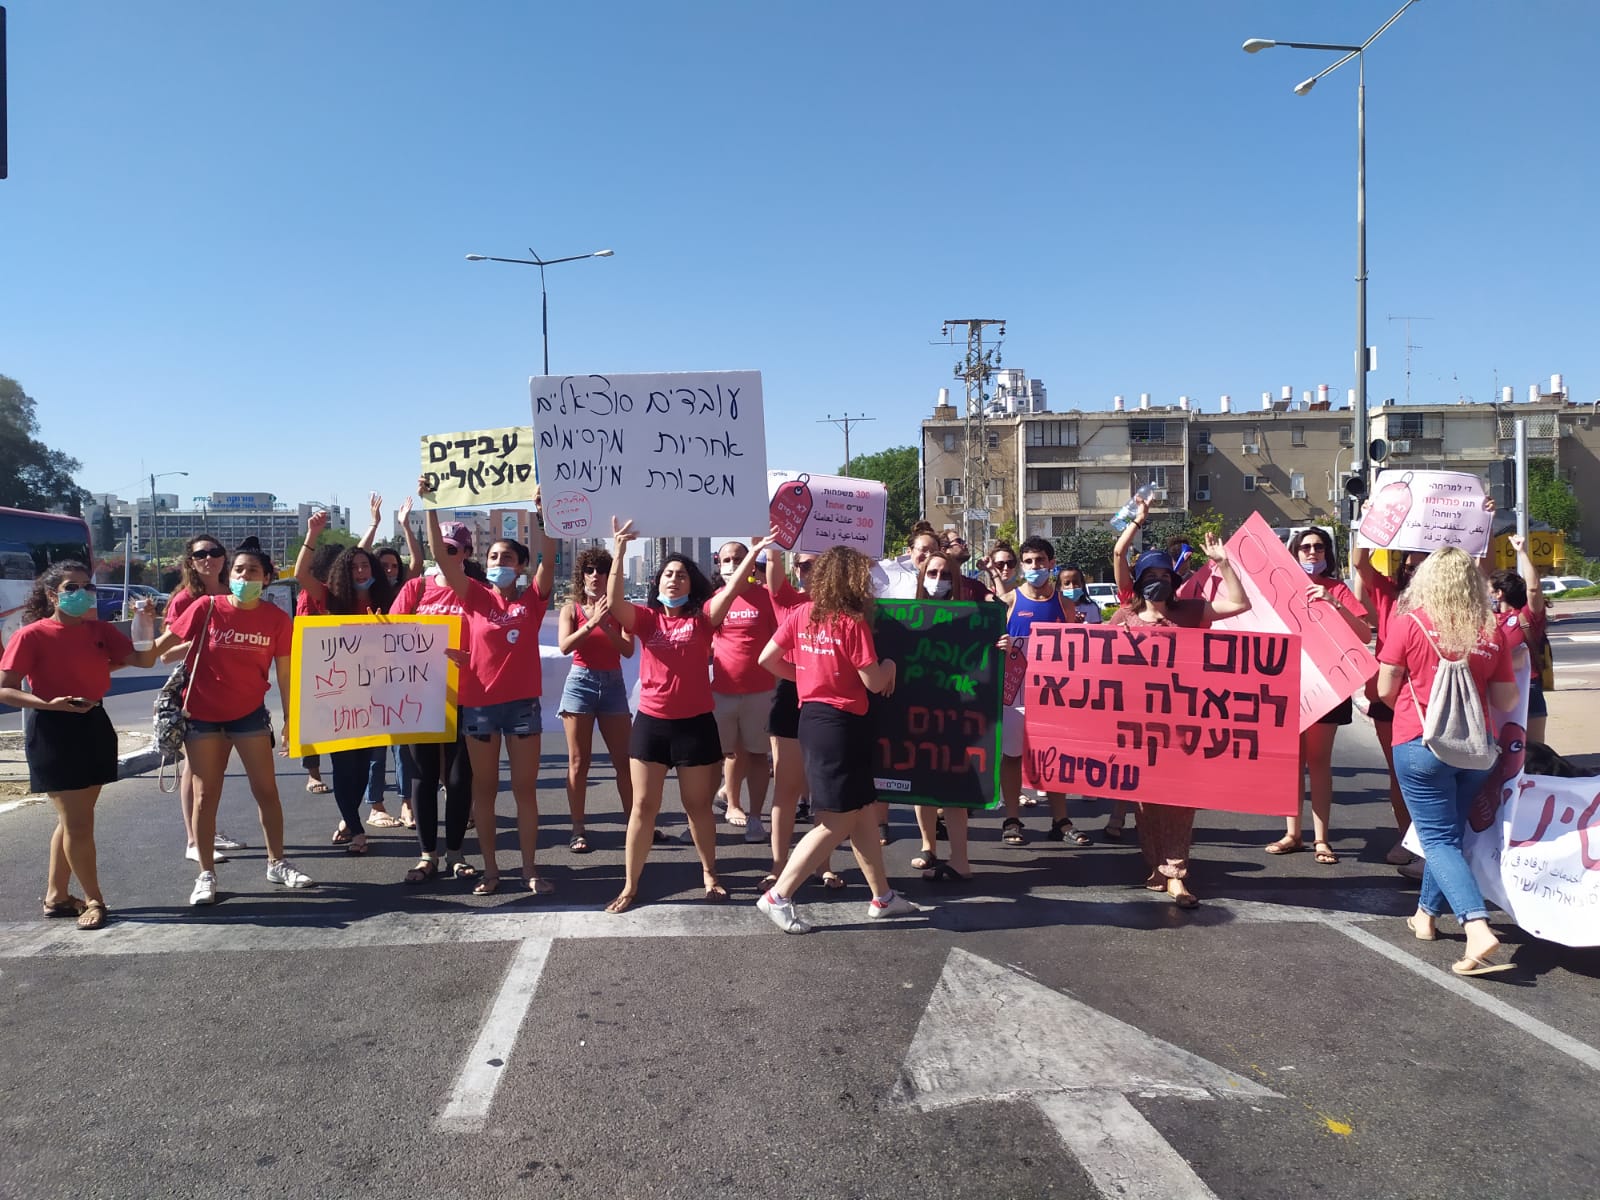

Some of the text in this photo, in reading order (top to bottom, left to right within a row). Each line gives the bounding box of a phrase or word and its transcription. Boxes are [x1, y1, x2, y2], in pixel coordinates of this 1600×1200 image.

[536, 374, 741, 420] עובדים סוציאליים
[429, 432, 518, 463] עבדים
[540, 423, 744, 465] אחריות מקסימום
[424, 460, 532, 495] סוציאליים
[554, 459, 735, 497] משכורת מינימום
[856, 517, 874, 528] 300
[321, 635, 362, 662] שינוי
[1036, 628, 1177, 671] הצדקה
[1203, 632, 1289, 676] שום
[315, 661, 429, 690] אומרים לא
[1034, 672, 1288, 727] לכאלה תנאי
[908, 705, 988, 736] היום
[876, 736, 987, 773] תורנו
[1117, 720, 1258, 766] העסקה
